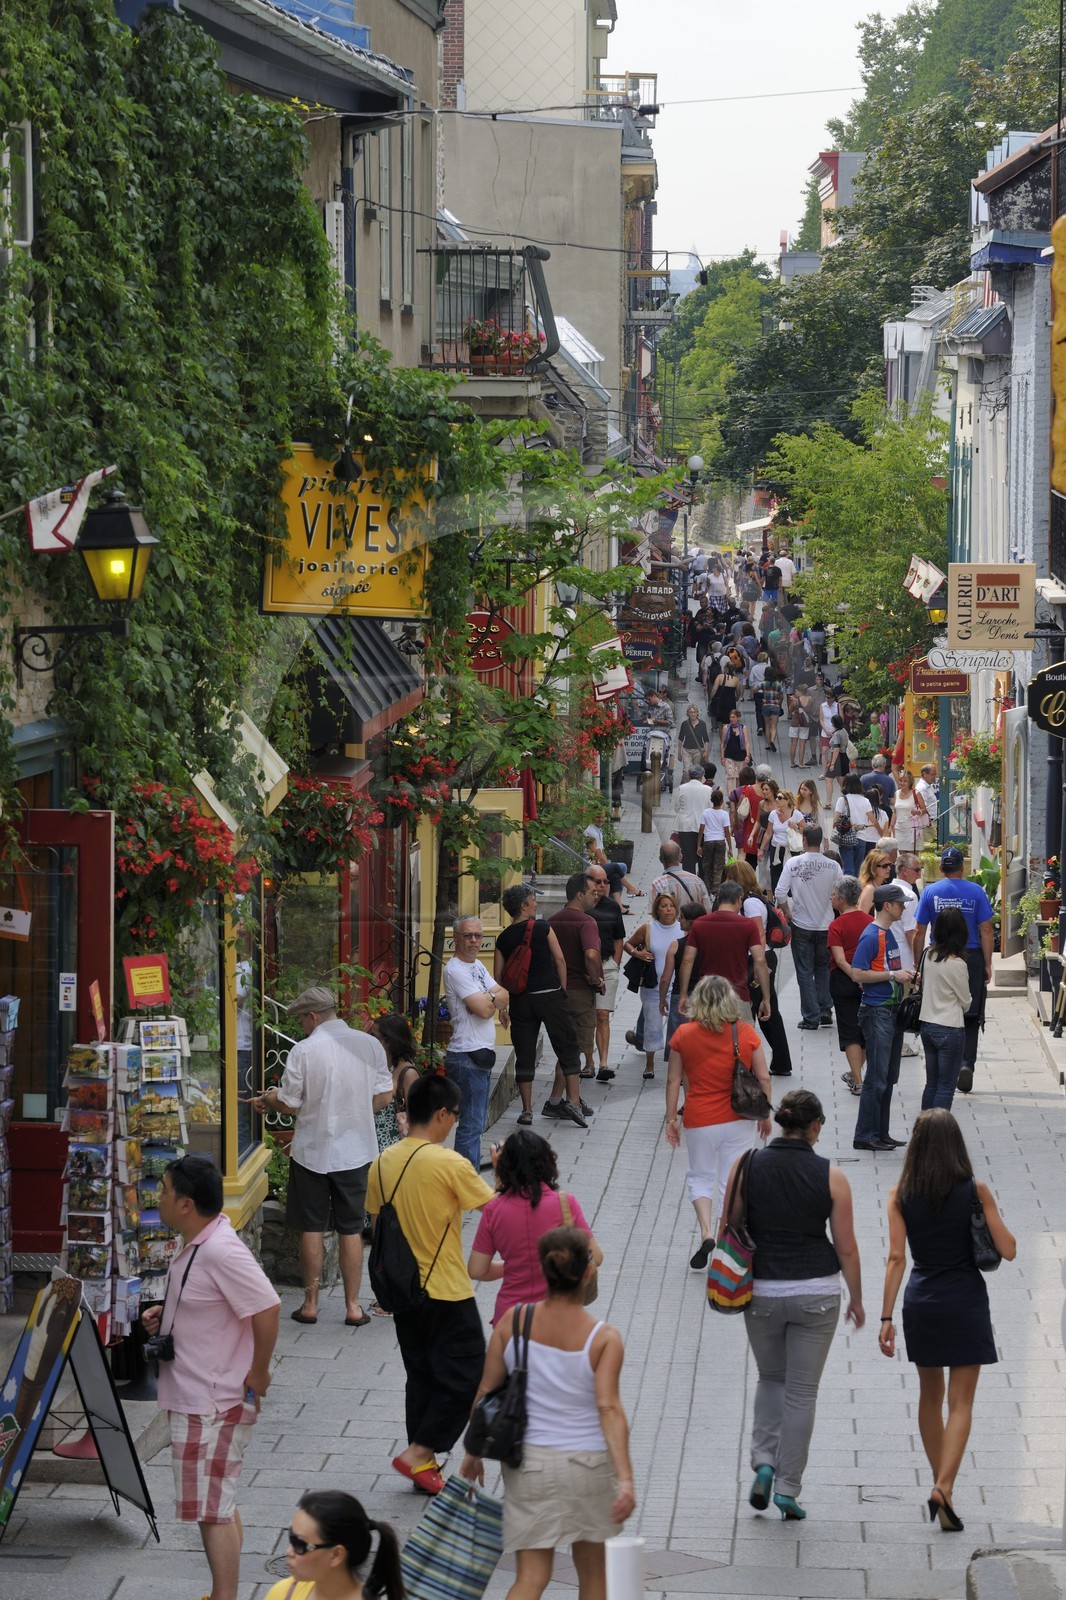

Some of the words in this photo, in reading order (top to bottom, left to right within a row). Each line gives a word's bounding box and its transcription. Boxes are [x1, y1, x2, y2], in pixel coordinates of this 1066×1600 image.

[301, 501, 401, 553] VIVES
[298, 558, 400, 575] joaillerie
[976, 587, 1020, 602] D'ART
[957, 573, 973, 640] GALERIE
[988, 625, 1019, 640] Denis
[625, 649, 653, 659] PERRIER
[931, 650, 1011, 672] Scrupules
[1045, 673, 1066, 681] Bouti
